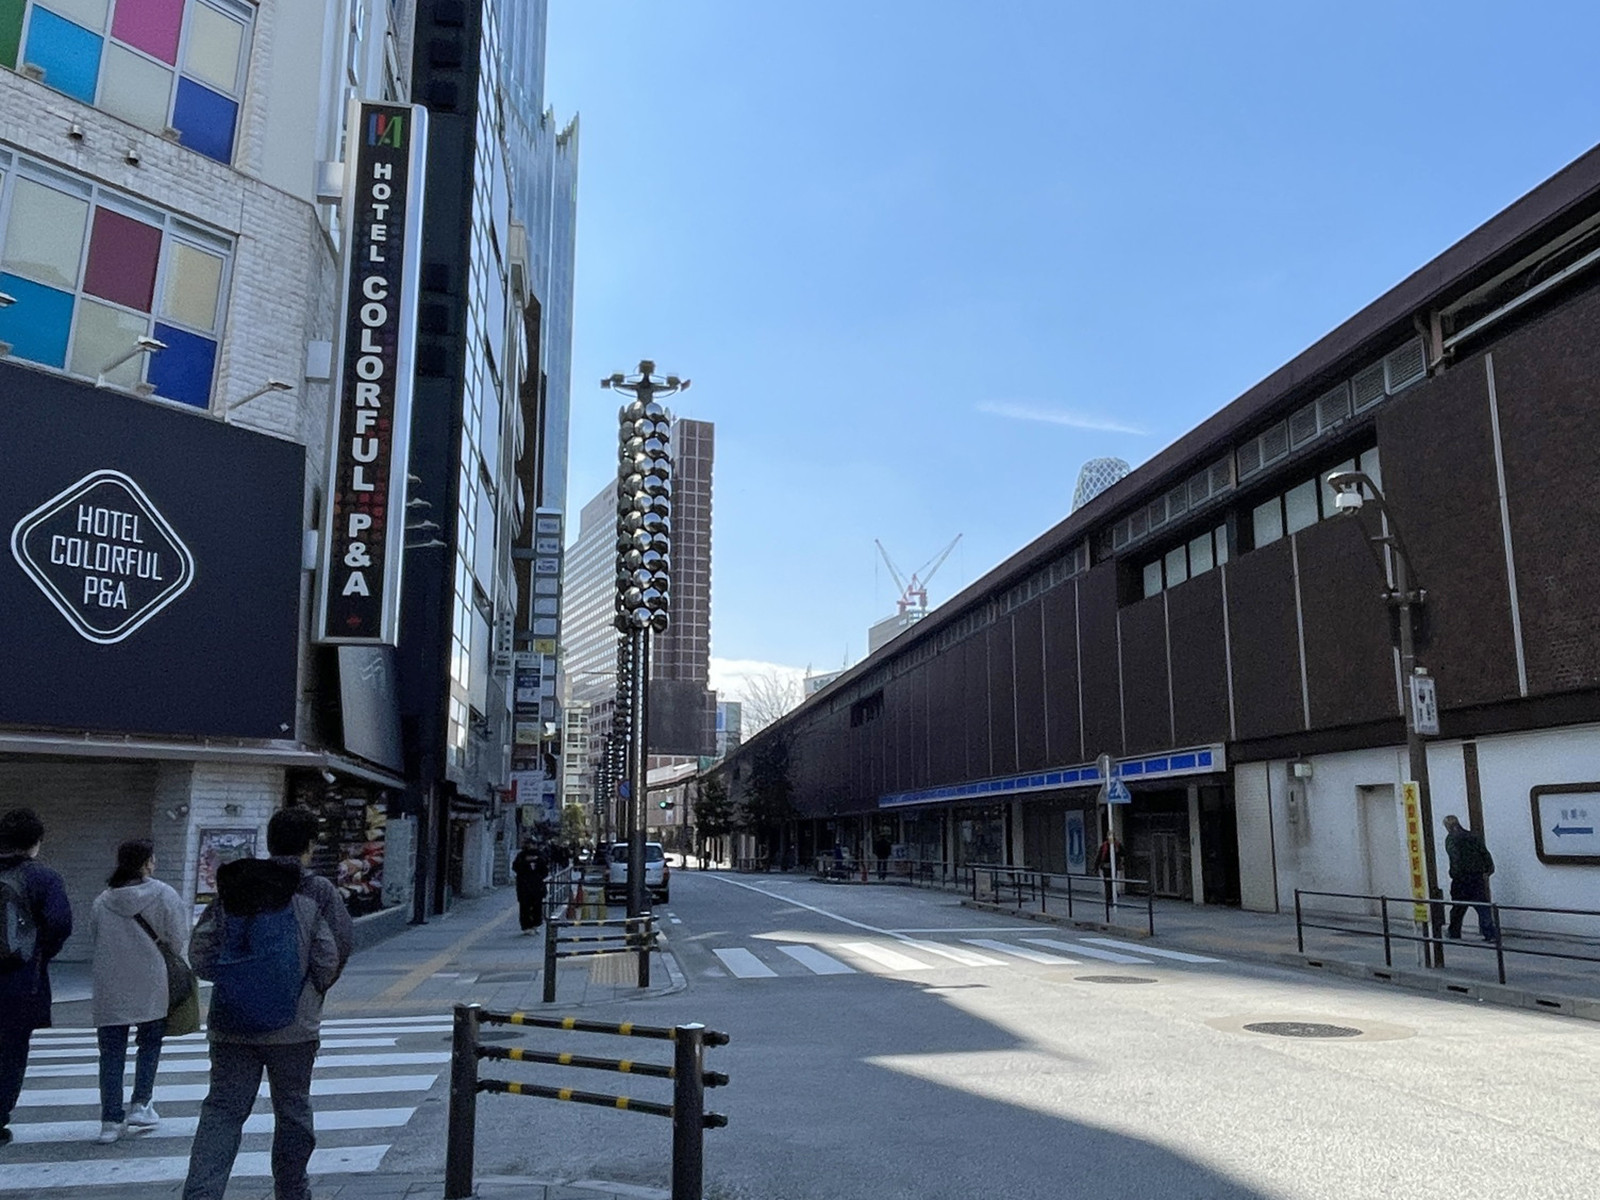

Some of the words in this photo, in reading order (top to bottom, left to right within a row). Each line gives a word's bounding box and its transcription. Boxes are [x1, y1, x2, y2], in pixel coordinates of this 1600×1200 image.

[369, 162, 392, 262] HOTEL
[351, 275, 389, 492] COLORFUL
[77, 504, 144, 544] HOTEL
[342, 513, 372, 597] P&A
[50, 535, 163, 581] COLORFUL
[83, 576, 128, 609] P&A
